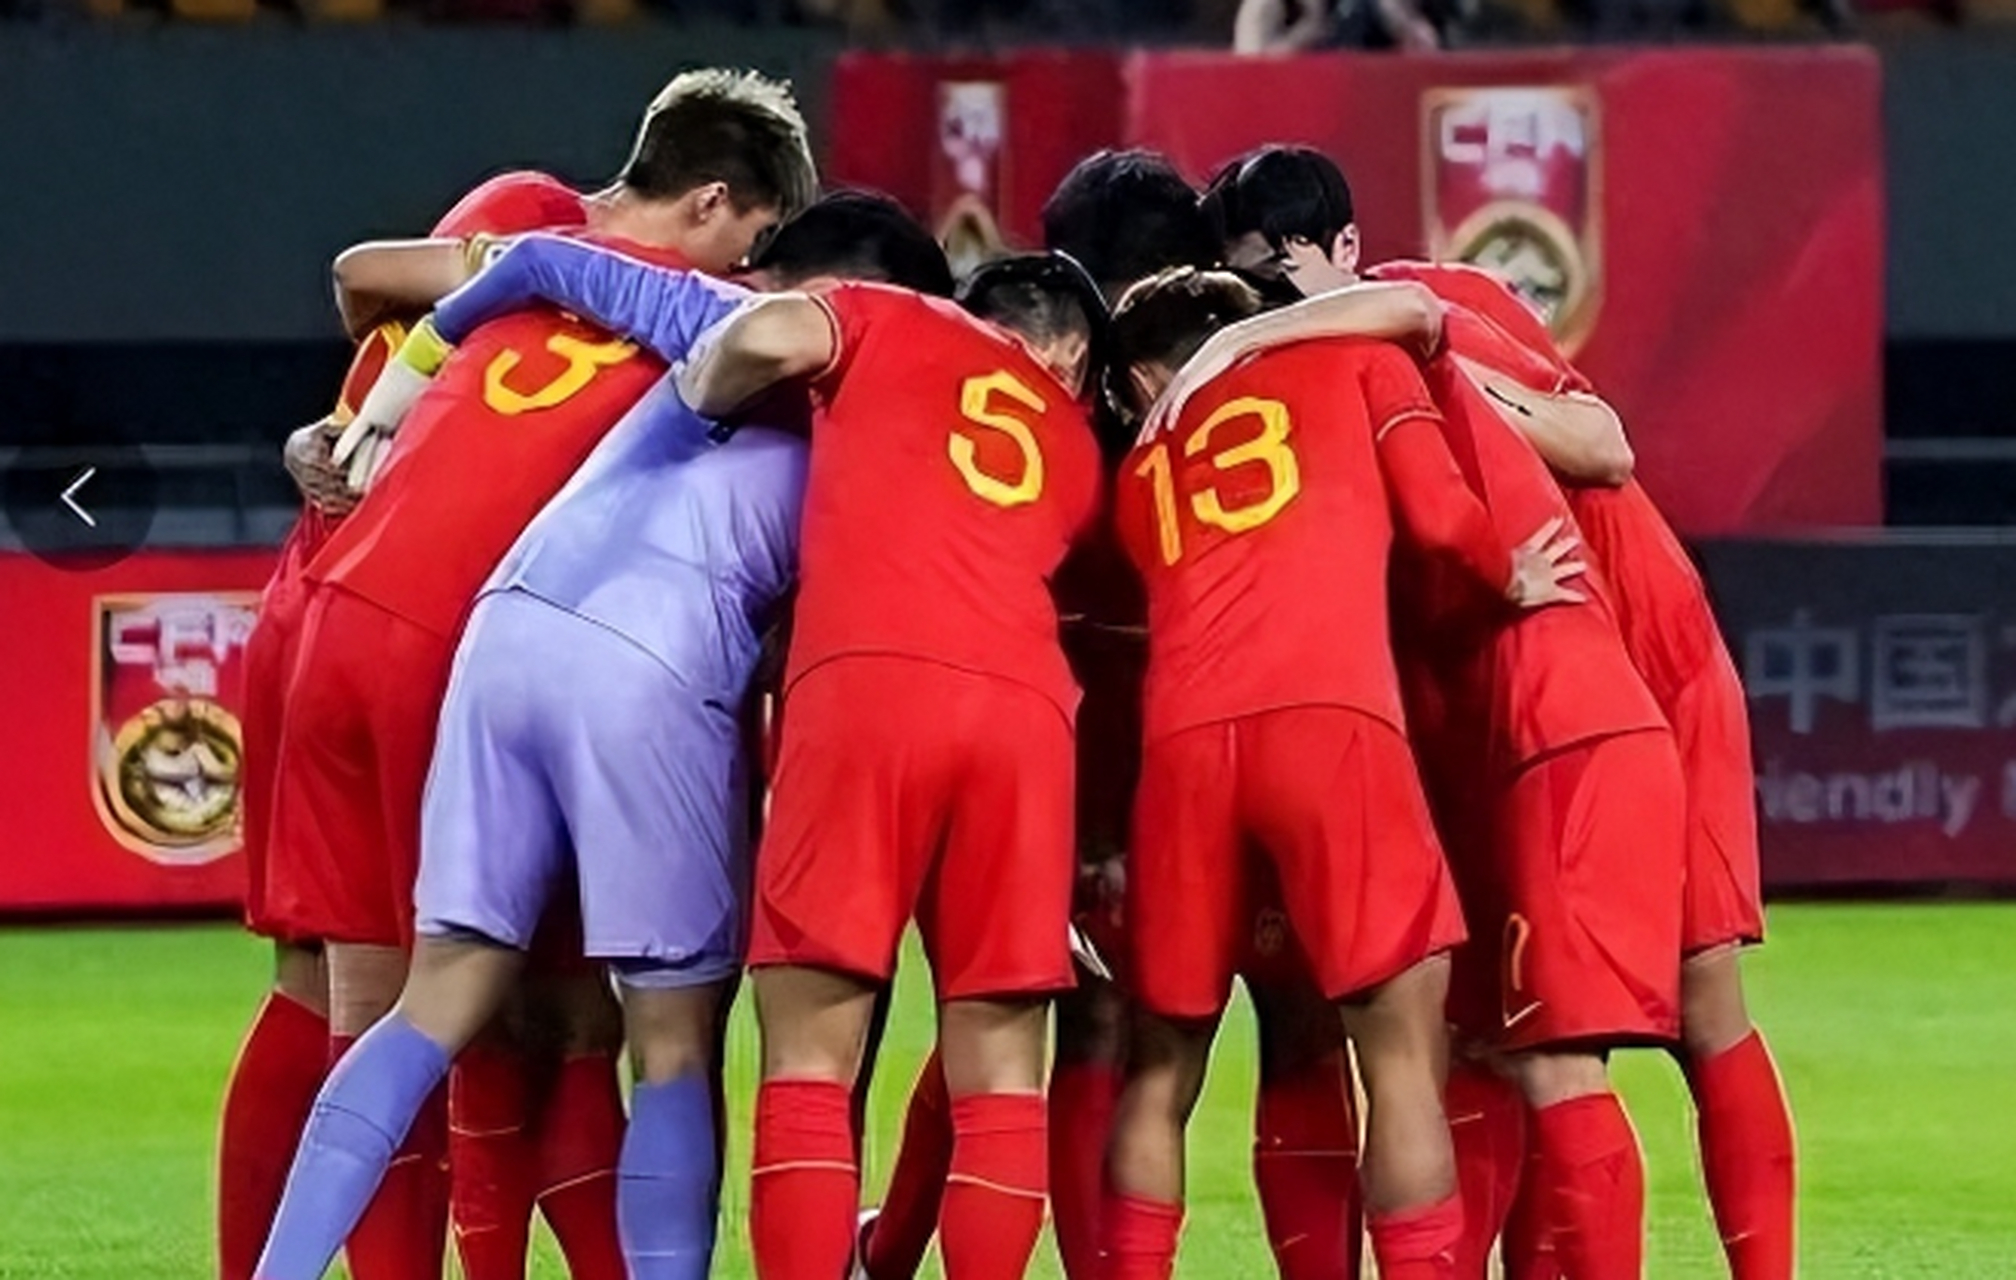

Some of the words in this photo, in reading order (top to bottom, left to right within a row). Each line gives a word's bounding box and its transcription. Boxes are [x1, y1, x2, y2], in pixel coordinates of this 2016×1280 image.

[484, 333, 640, 415] 3
[949, 369, 1046, 507] 5
[1135, 396, 1301, 566] 13
[1749, 608, 2016, 733] 中国
[1755, 760, 1982, 838] iendly
